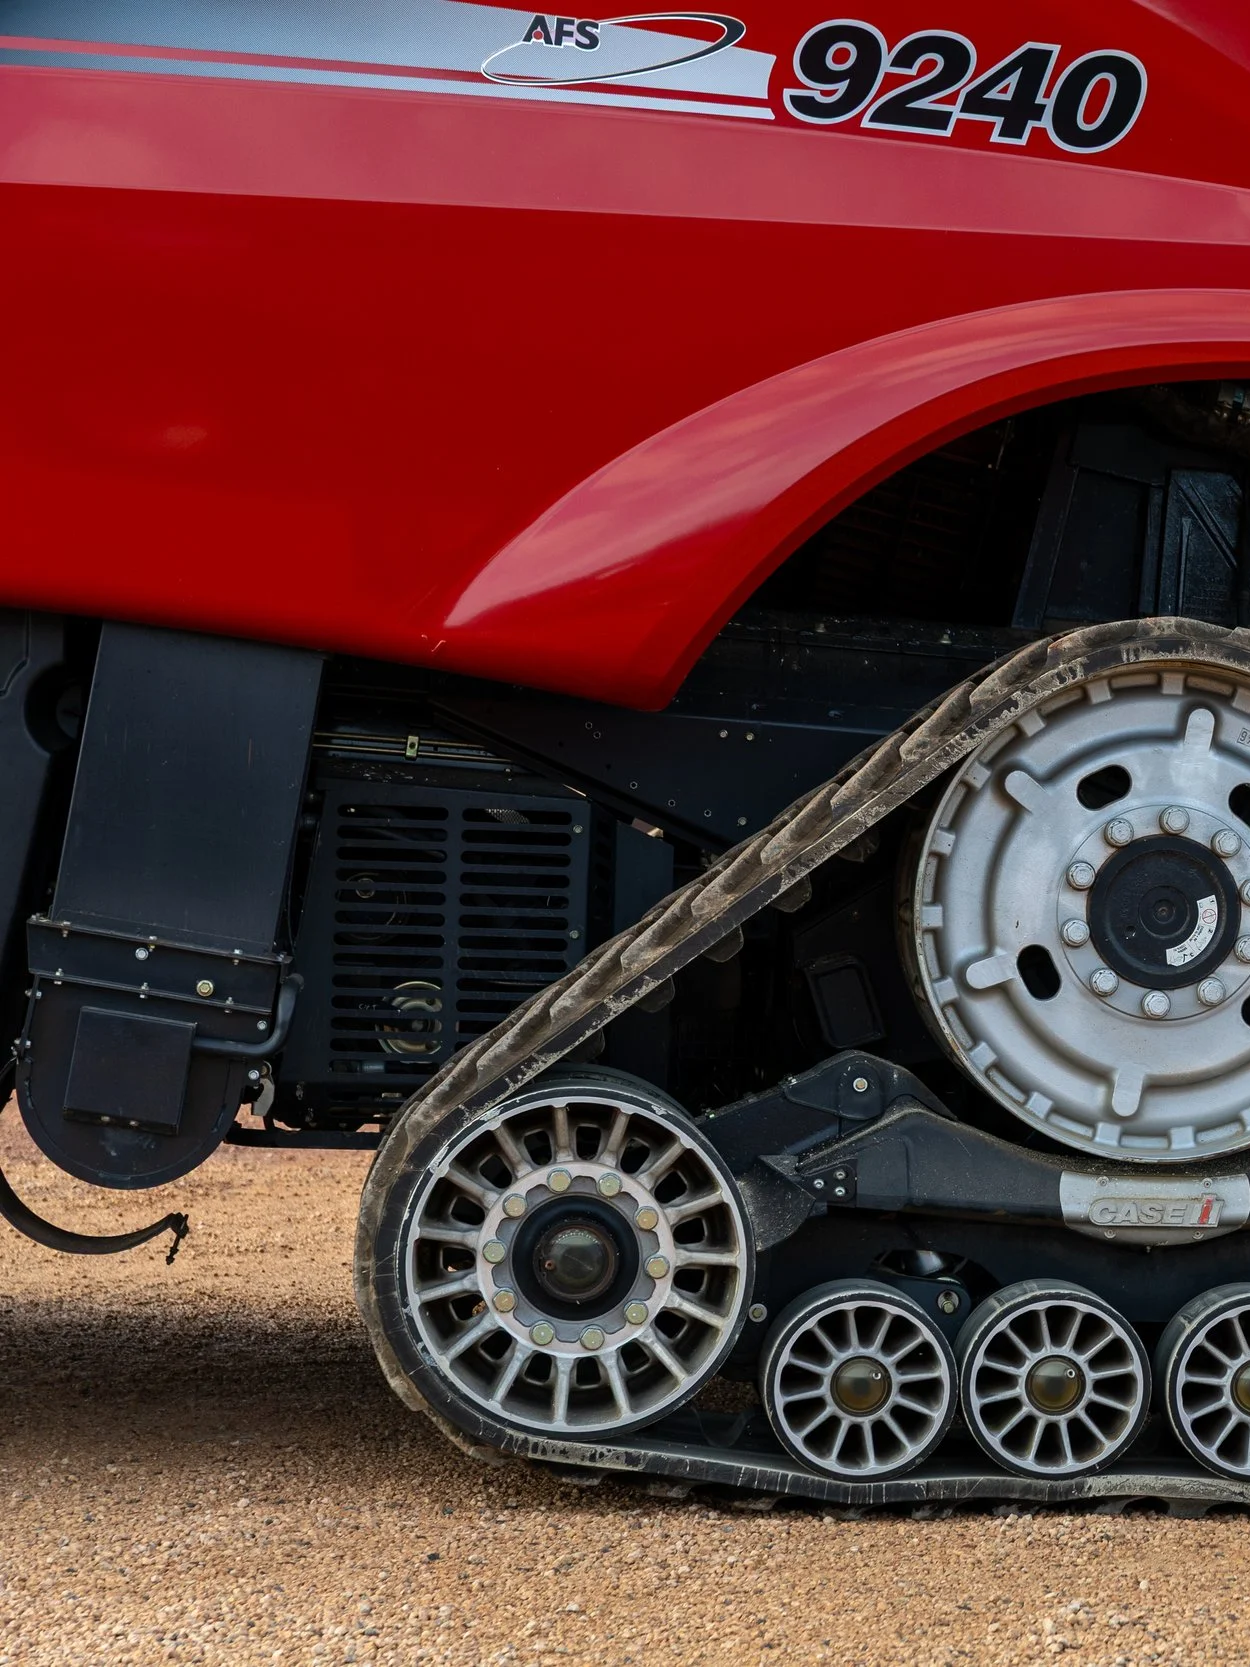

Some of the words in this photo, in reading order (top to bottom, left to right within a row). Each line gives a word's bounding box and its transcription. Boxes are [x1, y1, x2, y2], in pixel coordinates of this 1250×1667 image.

[521, 14, 601, 51] AFS
[783, 18, 1148, 154] 9240
[1090, 1200, 1188, 1225] CASE
